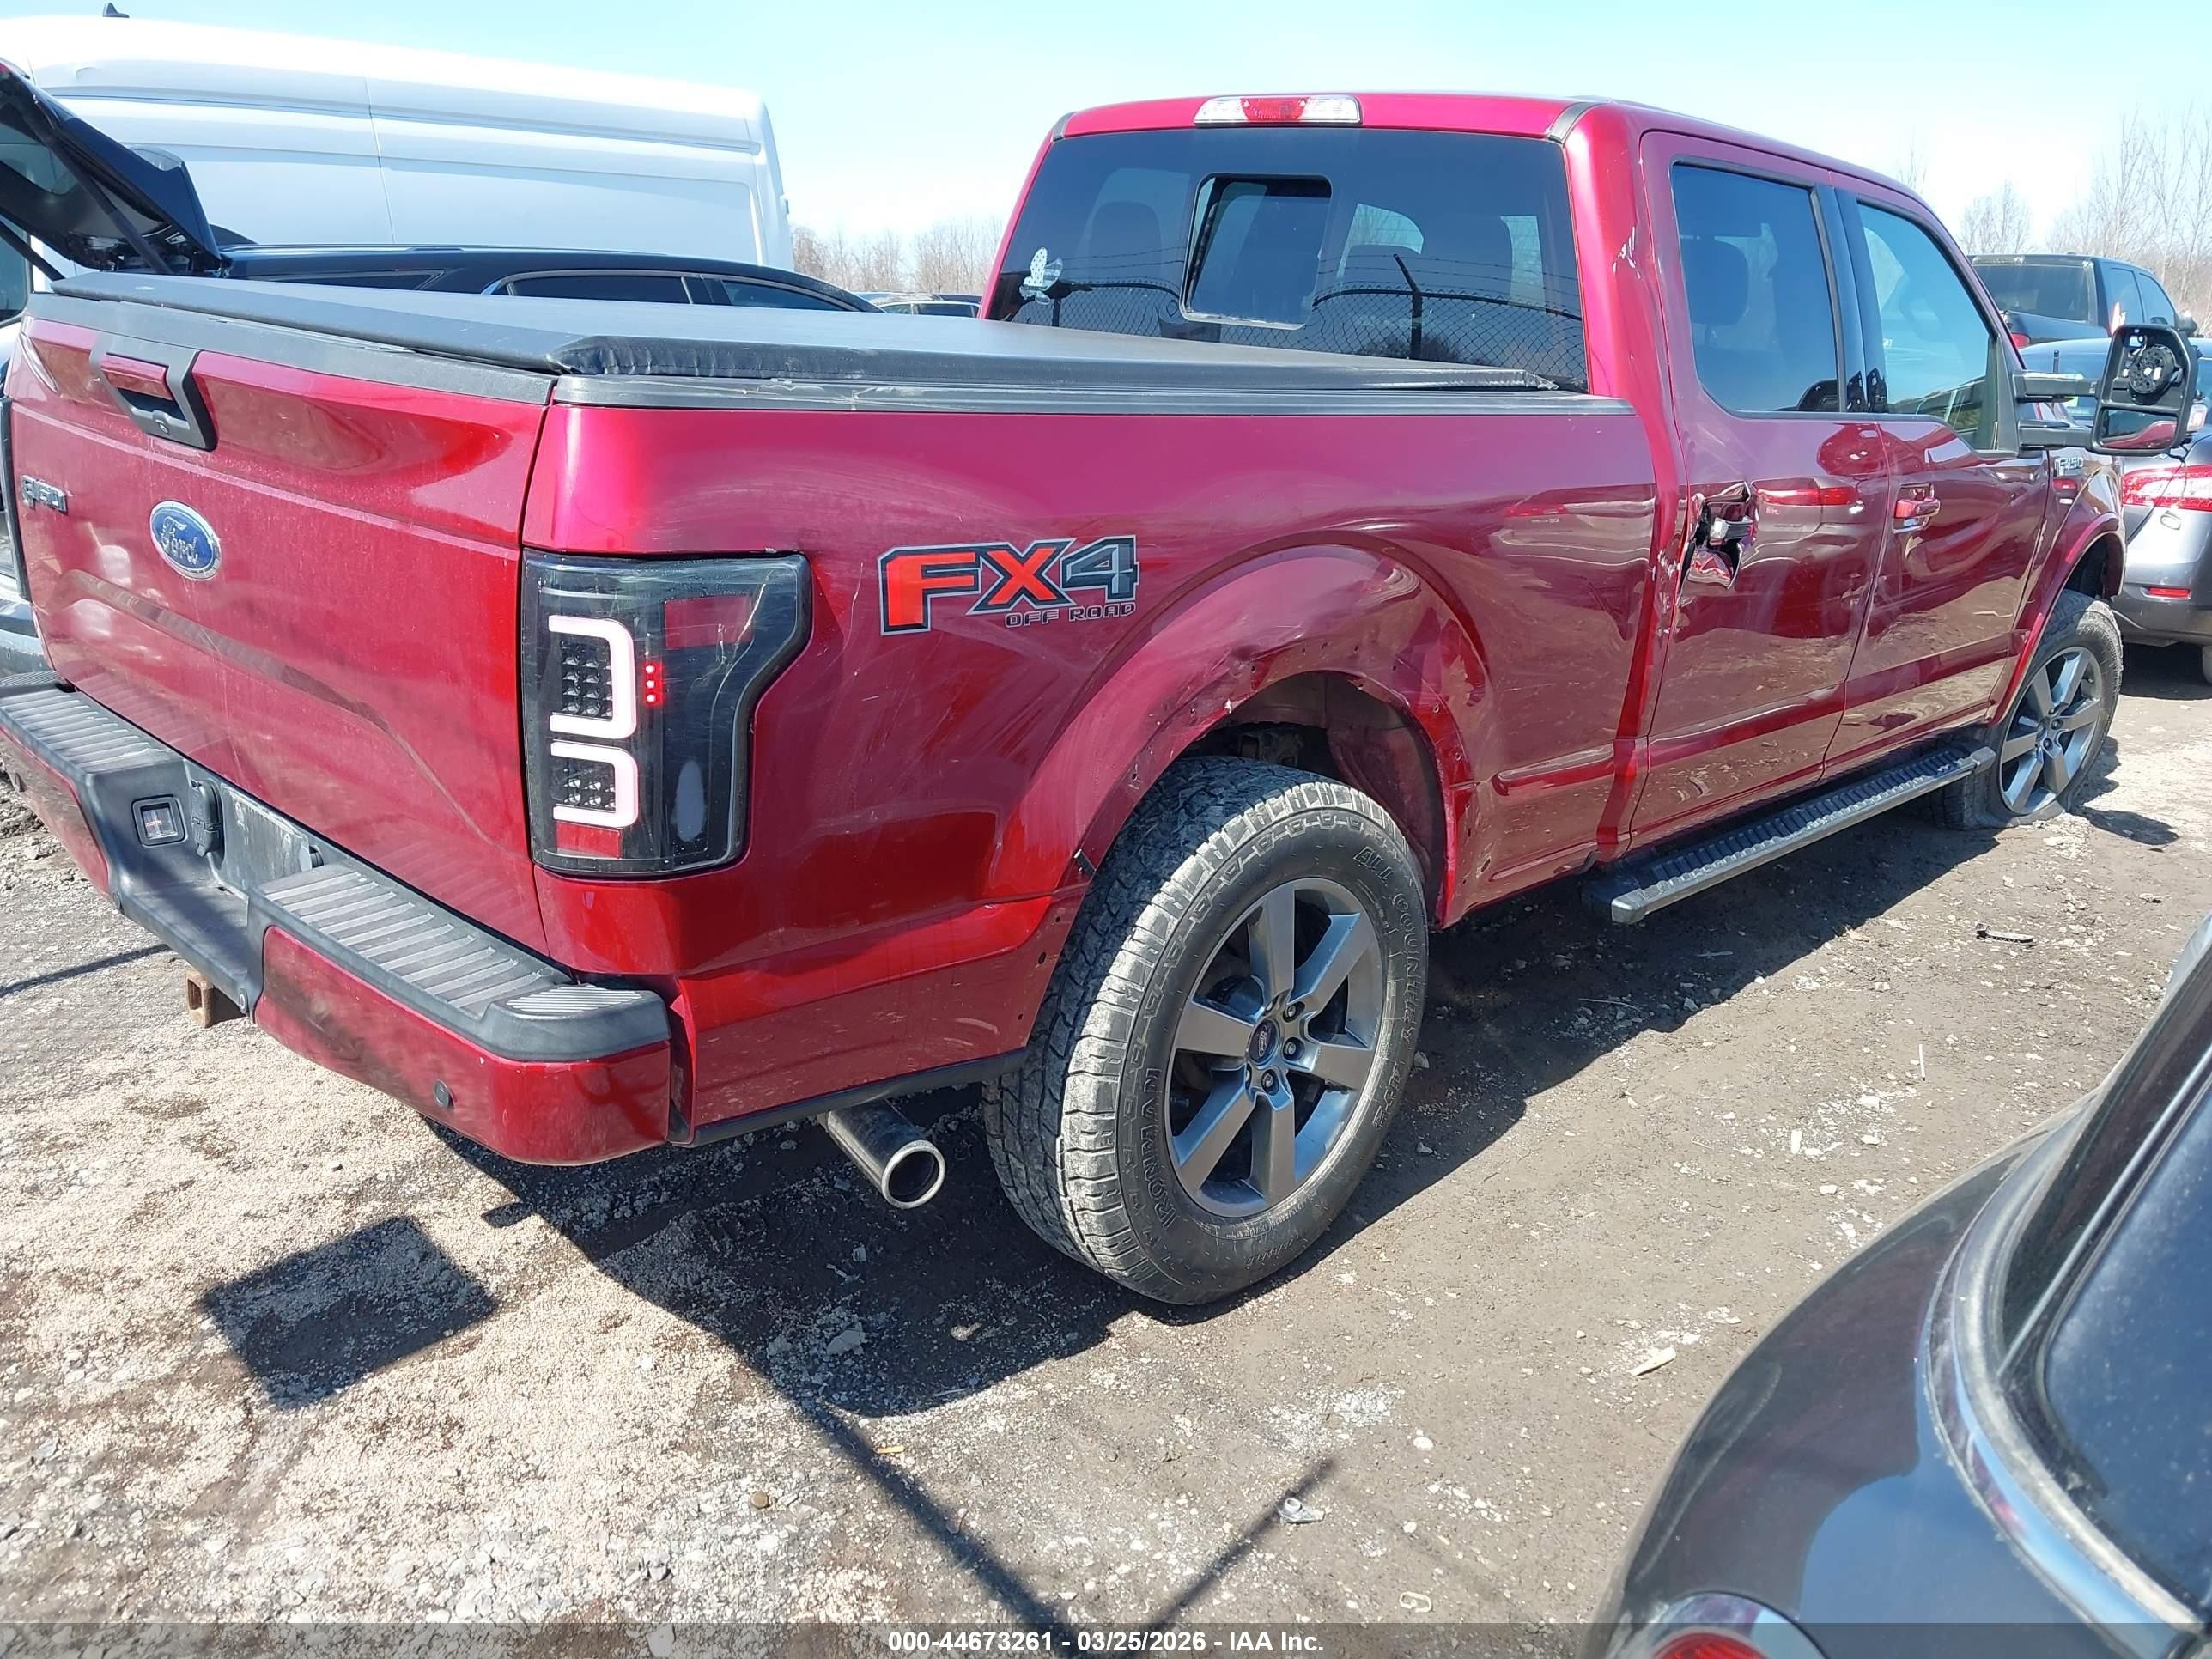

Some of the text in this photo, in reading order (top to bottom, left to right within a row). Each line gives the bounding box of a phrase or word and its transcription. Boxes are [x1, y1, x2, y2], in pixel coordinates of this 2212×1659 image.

[878, 535, 1140, 636] FX4
[1005, 601, 1136, 629] OFF ROAD
[1140, 1067, 1178, 1231] IRONMAN
